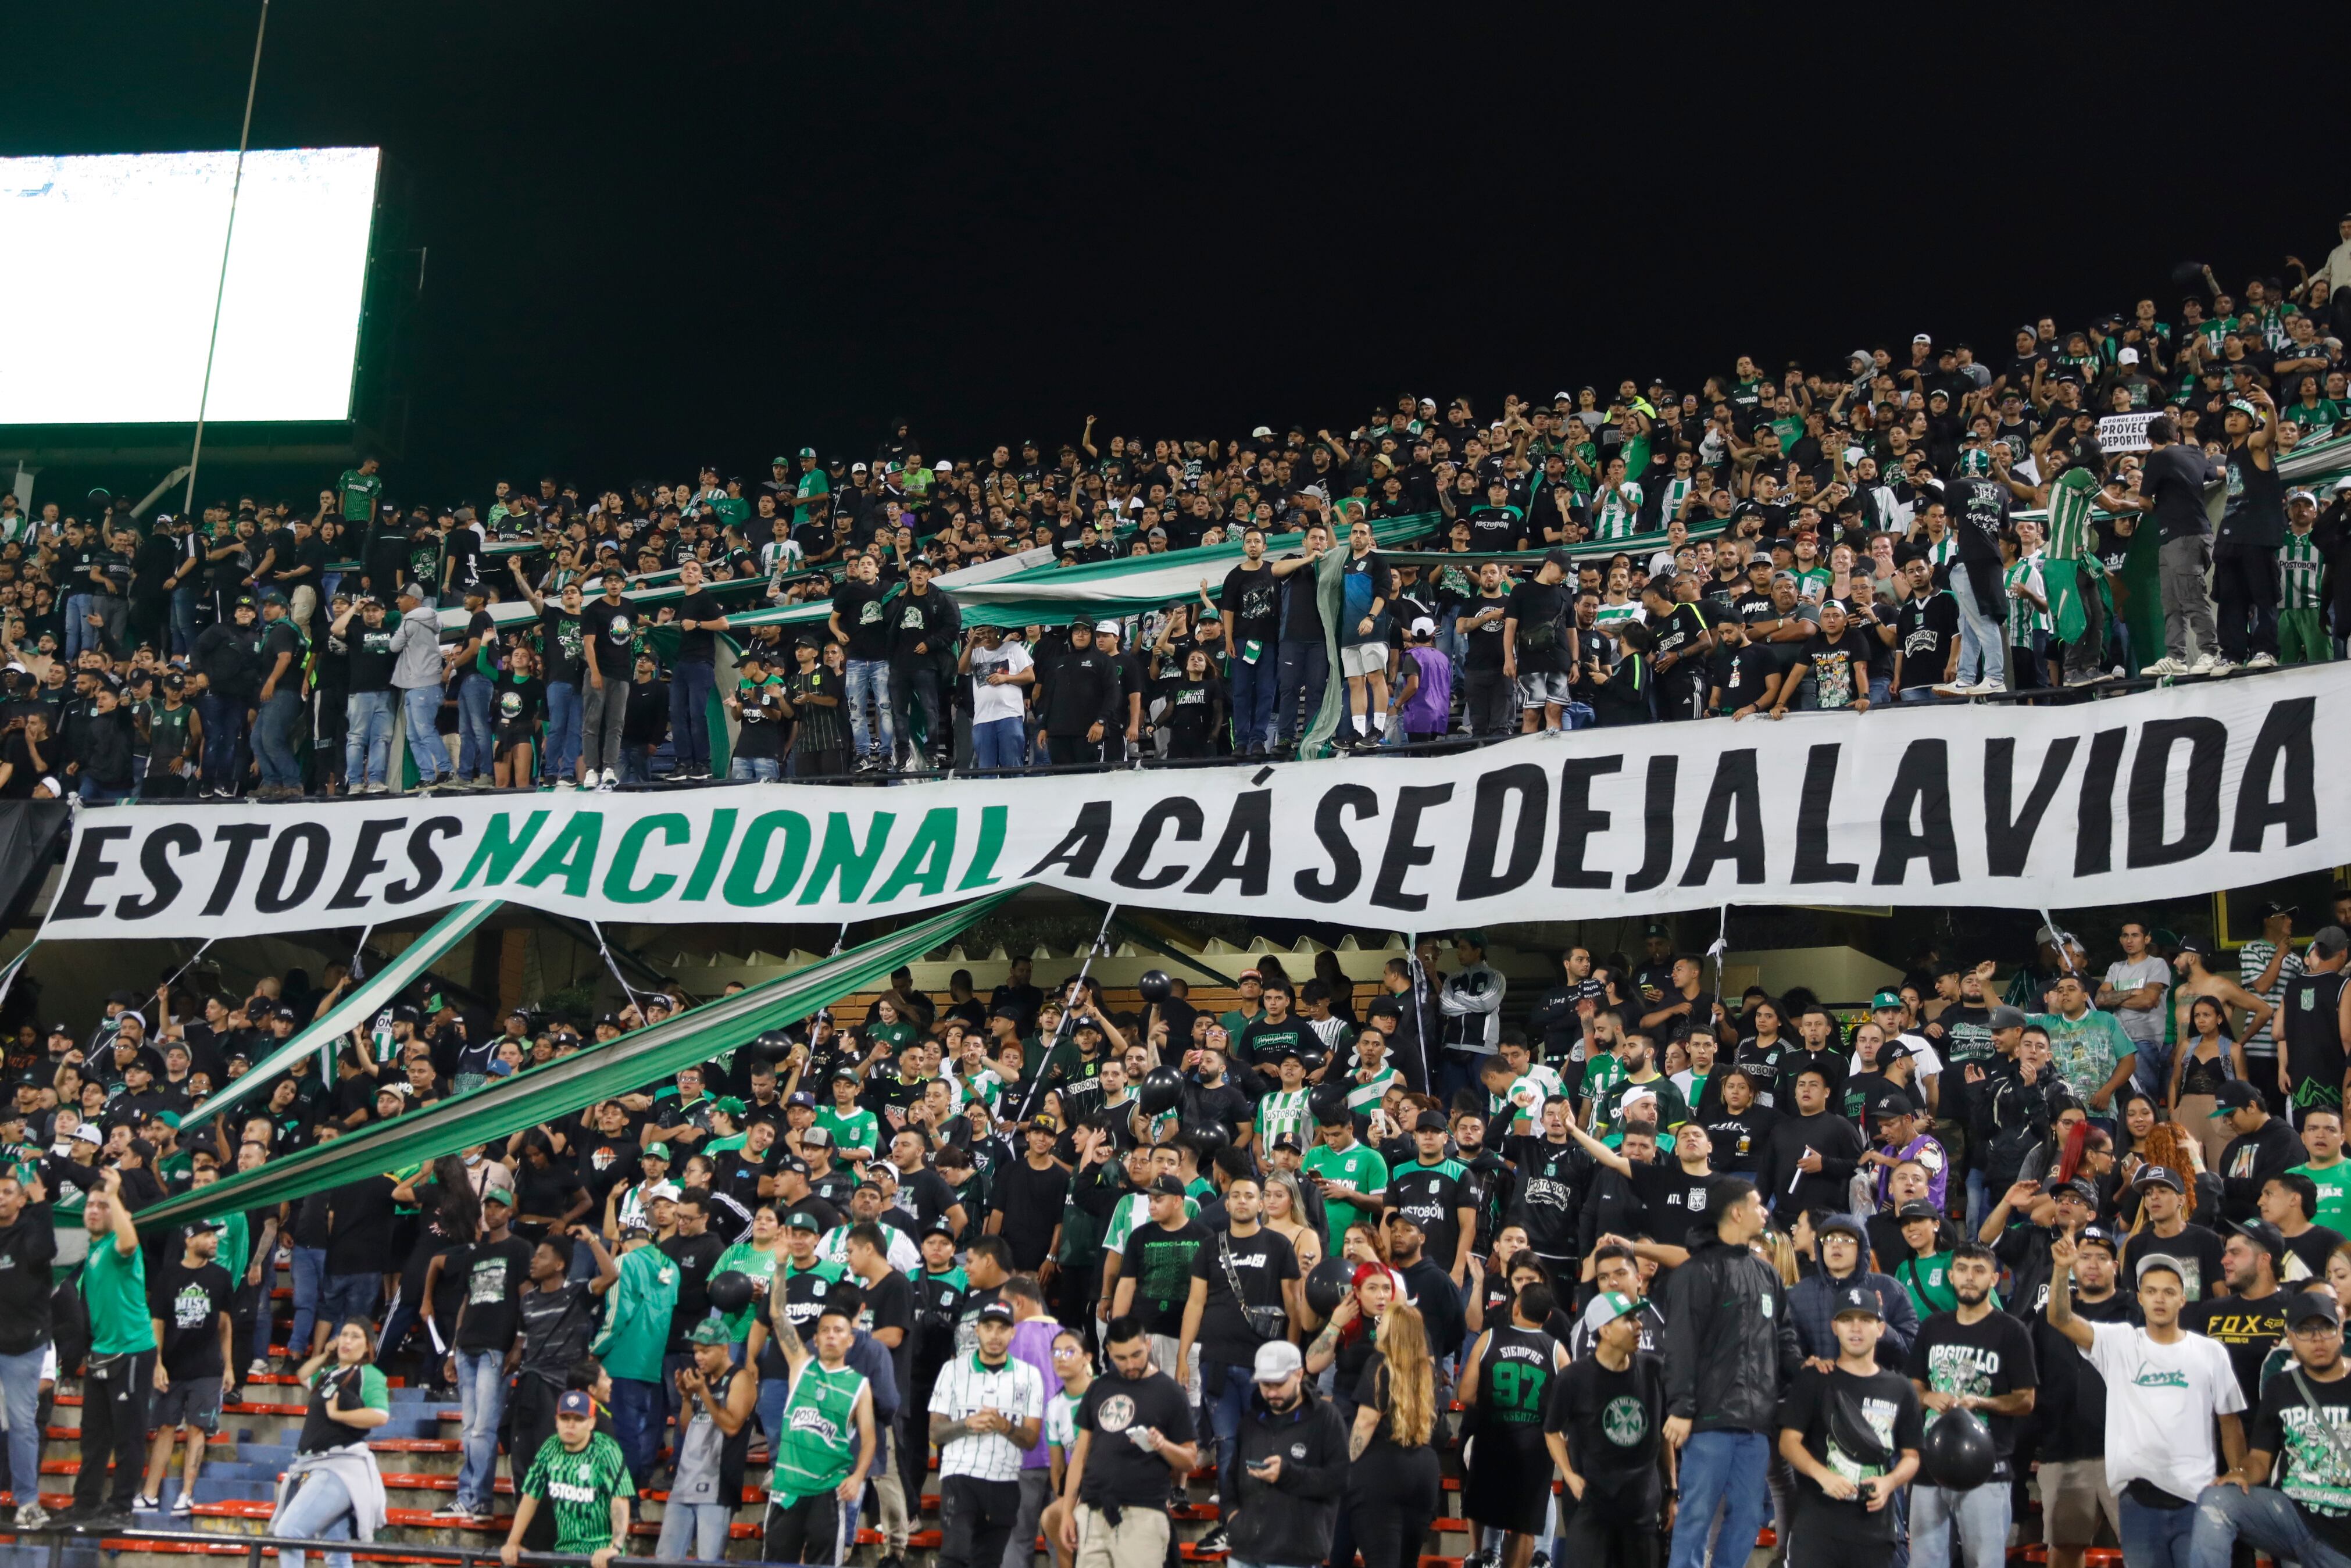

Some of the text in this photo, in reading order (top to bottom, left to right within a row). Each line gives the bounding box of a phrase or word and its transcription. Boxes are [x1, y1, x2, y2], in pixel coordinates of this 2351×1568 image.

[1475, 521, 1509, 530] POSTOBON
[2279, 561, 2317, 572] POSTOBON
[1742, 602, 1768, 615] VAMOS
[49, 696, 2320, 923] ESTO ES NACIONAL ACÁ SE DEJA LA VIDA
[1264, 1109, 1302, 1120] POSTOBON
[1667, 1194, 1681, 1205] ATL
[2208, 1315, 2261, 1333] FOX
[1500, 1345, 1543, 1365] SIEMPRE
[1492, 1362, 1546, 1410] 97
